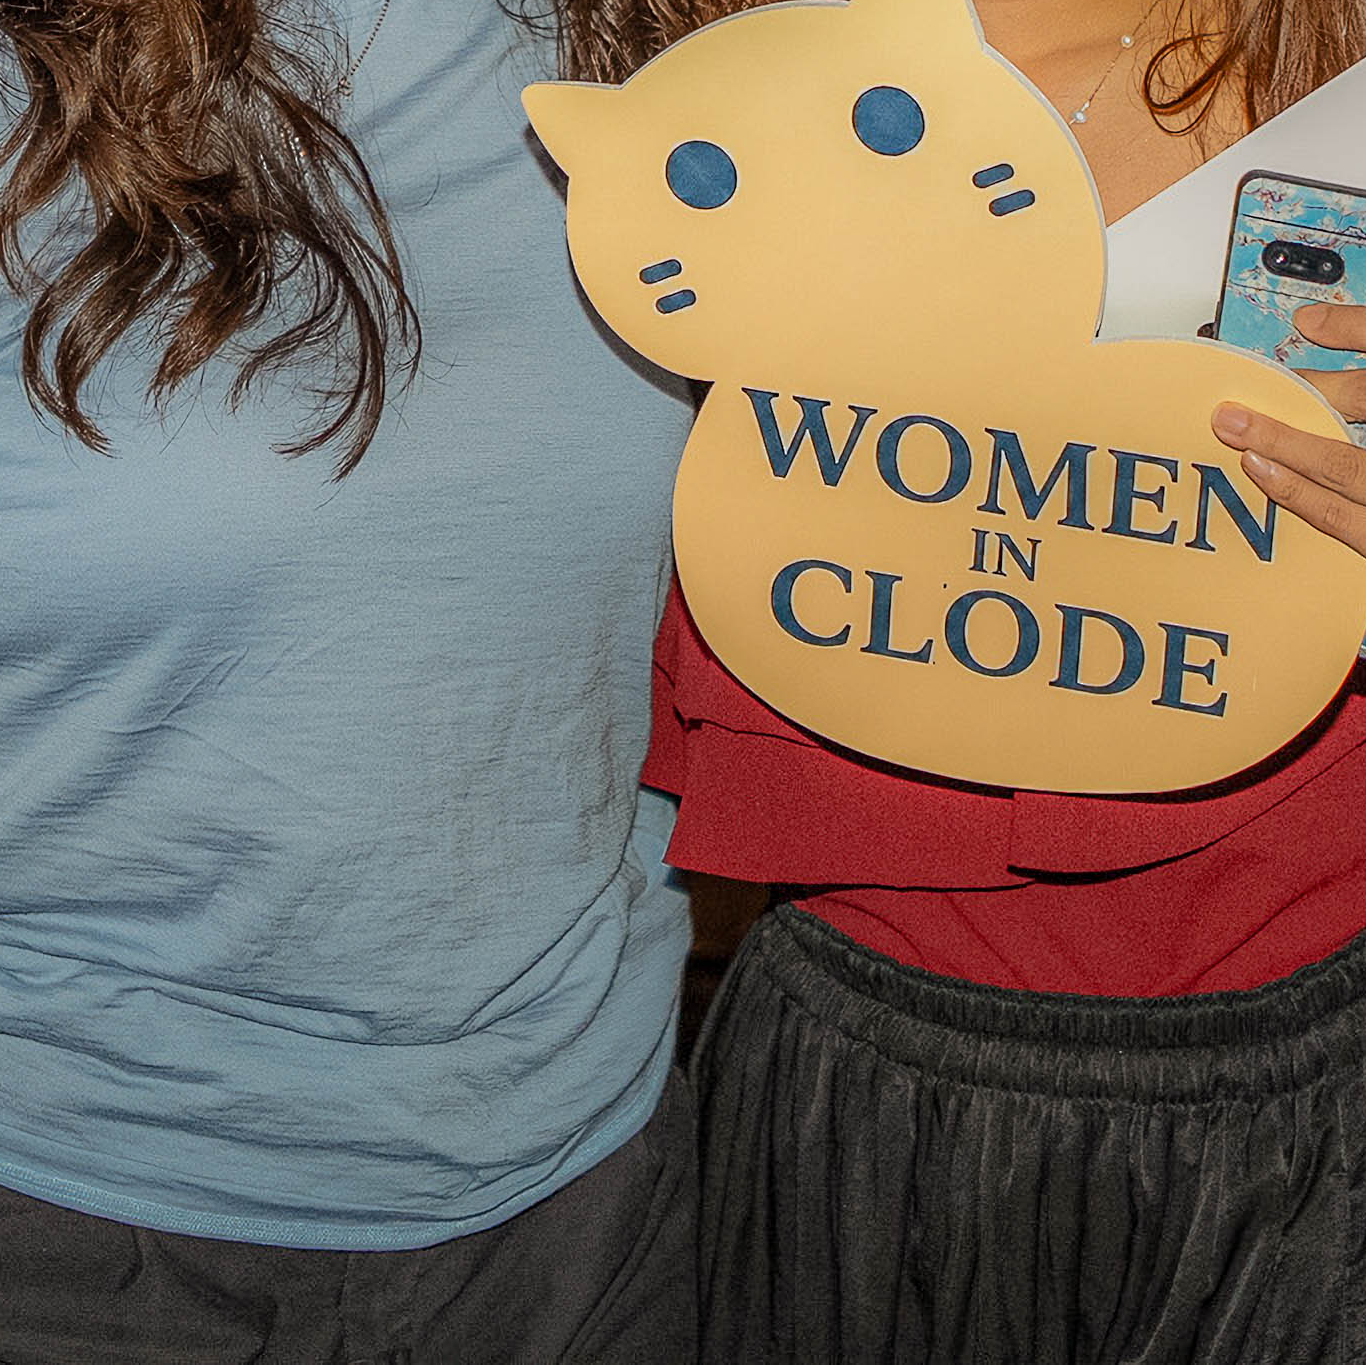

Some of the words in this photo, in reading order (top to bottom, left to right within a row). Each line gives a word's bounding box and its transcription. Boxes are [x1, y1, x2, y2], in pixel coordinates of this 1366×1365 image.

[742, 387, 1277, 563] WOMEN
[970, 529, 1041, 582] IN
[770, 557, 1229, 718] CLODE
